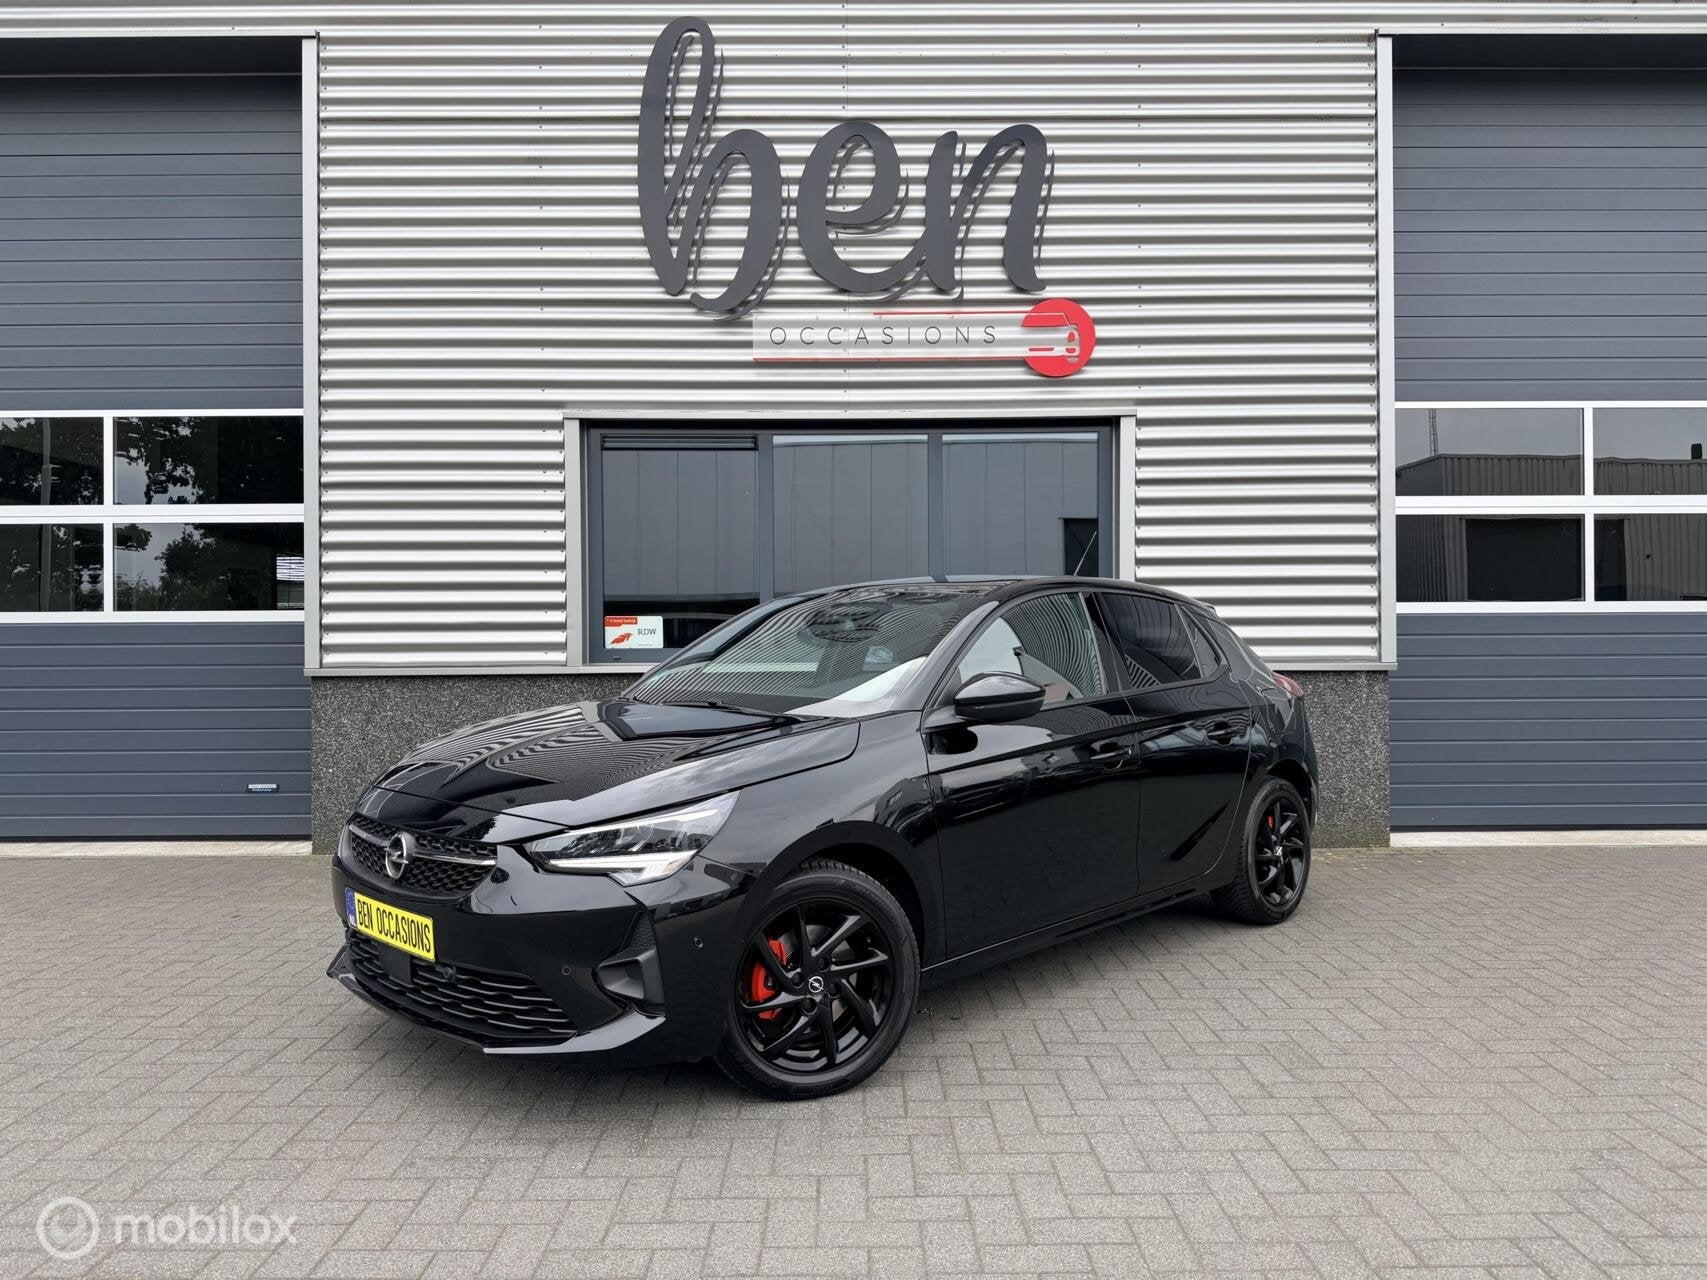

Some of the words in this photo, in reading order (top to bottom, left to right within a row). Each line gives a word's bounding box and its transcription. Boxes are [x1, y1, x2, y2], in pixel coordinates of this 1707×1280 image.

[637, 16, 1047, 311] ben
[769, 325, 997, 346] OCCASIONS
[637, 628, 656, 636] RDW
[357, 899, 373, 931] BEN
[376, 907, 431, 953] OCCASIONS
